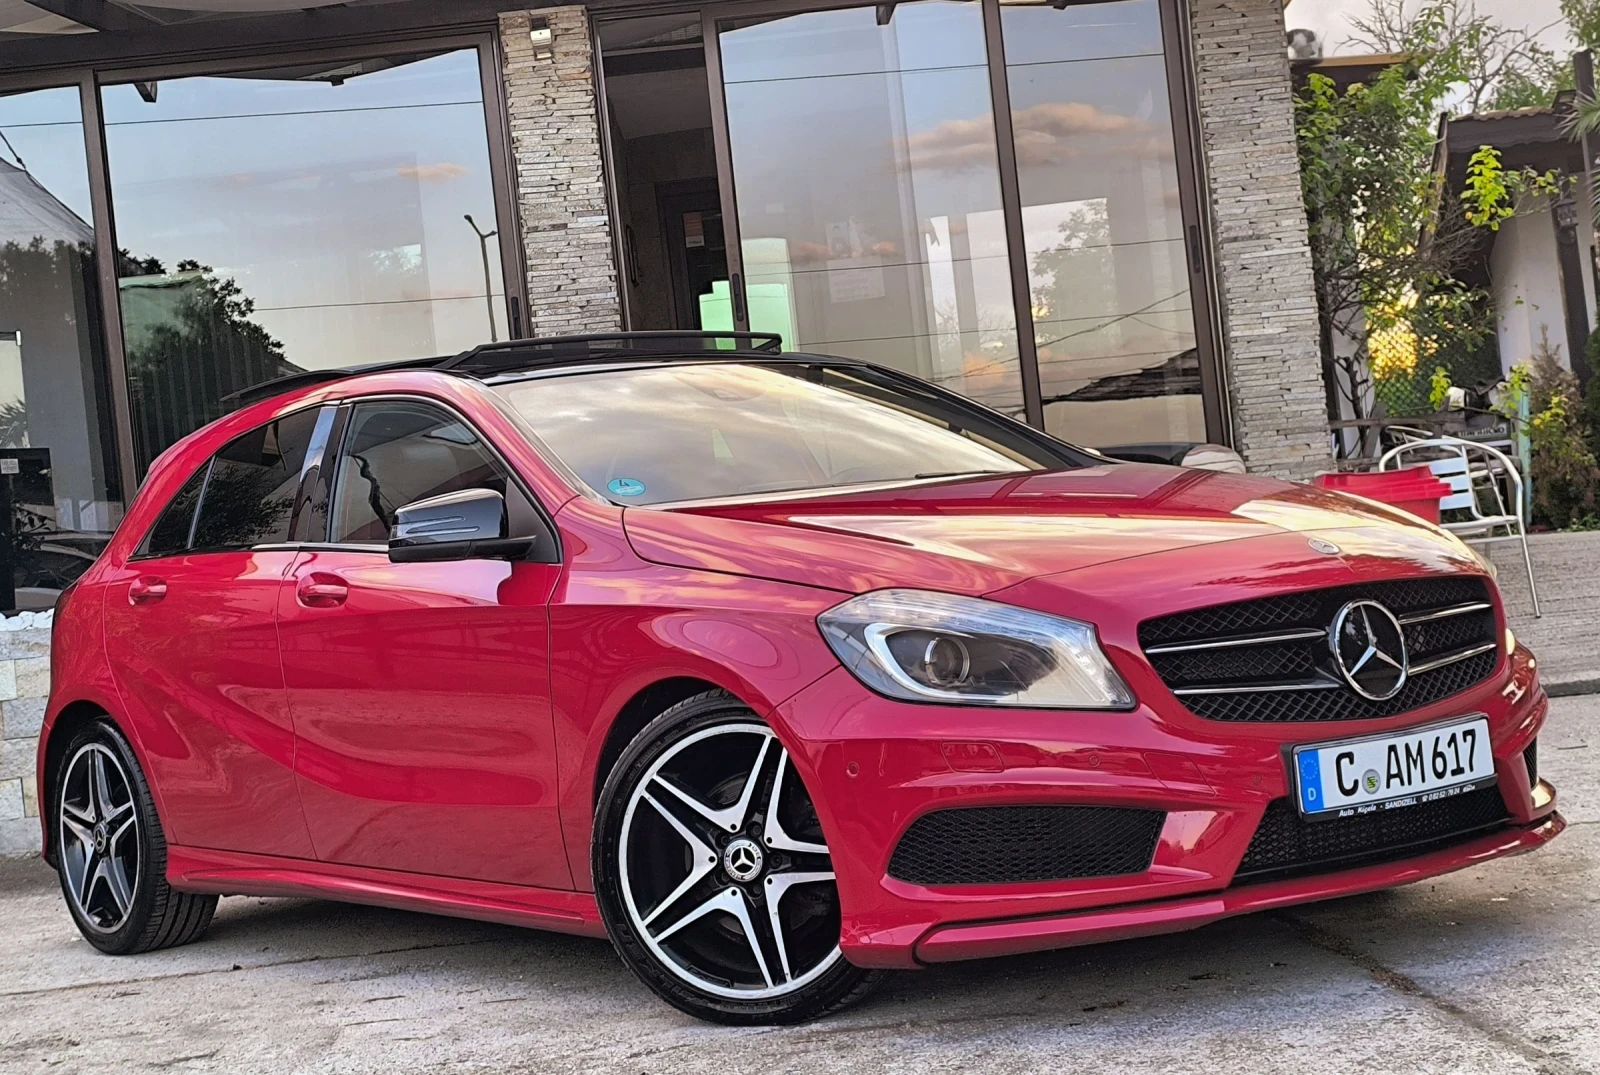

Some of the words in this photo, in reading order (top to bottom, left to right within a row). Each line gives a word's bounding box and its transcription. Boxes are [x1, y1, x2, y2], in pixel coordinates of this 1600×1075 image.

[1335, 751, 1359, 797] C
[1386, 740, 1426, 789] AM
[1431, 728, 1476, 780] 617
[1308, 788, 1317, 801] D
[1338, 809, 1355, 818] Auto
[1385, 798, 1417, 809] SANDIZELL
